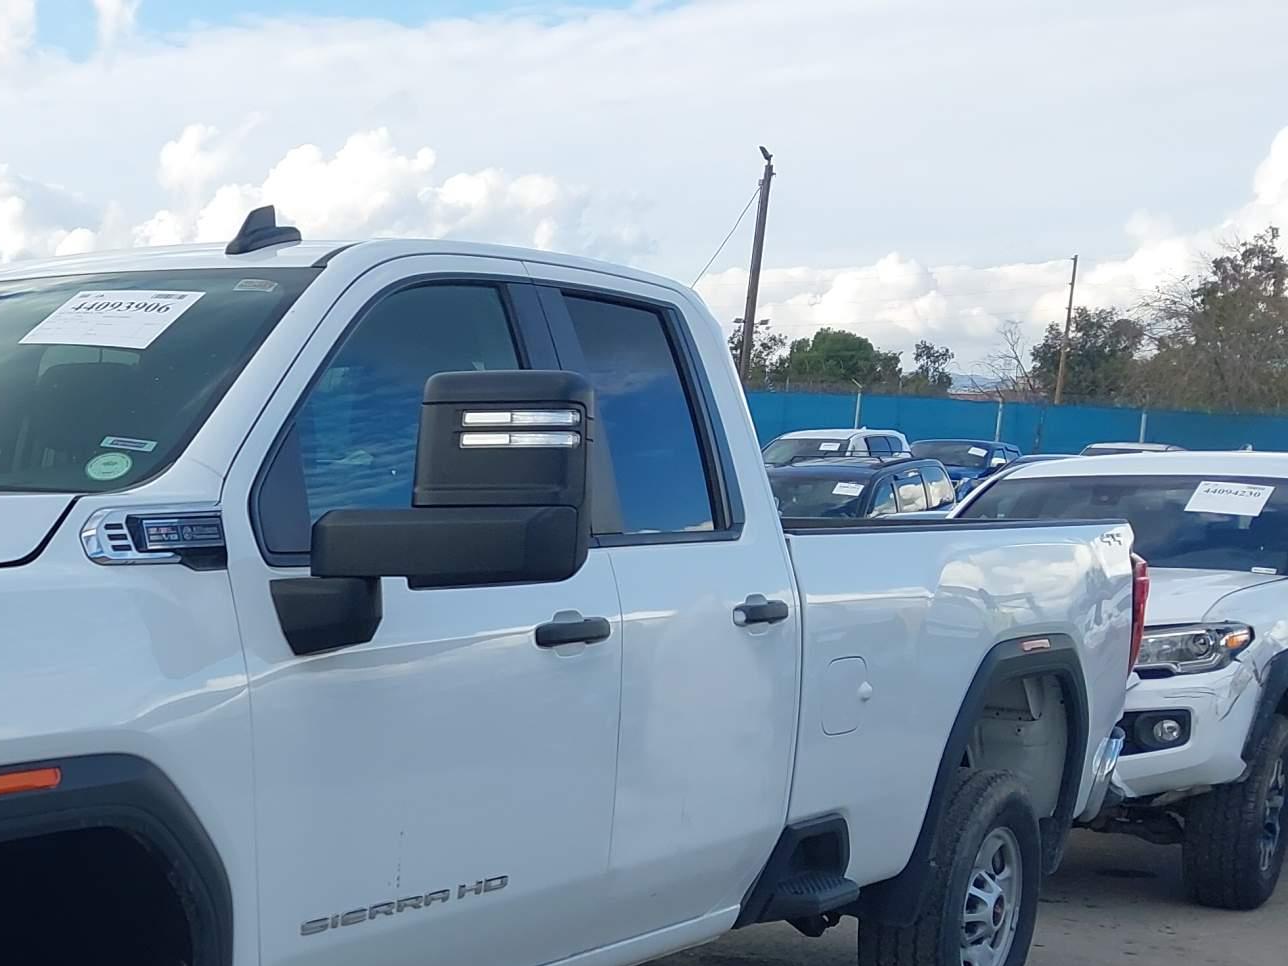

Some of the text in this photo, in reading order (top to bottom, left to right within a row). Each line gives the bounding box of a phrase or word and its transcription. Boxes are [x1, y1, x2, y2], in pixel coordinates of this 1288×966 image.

[70, 301, 172, 314] 44093906
[300, 875, 509, 937] SIERRA HD
